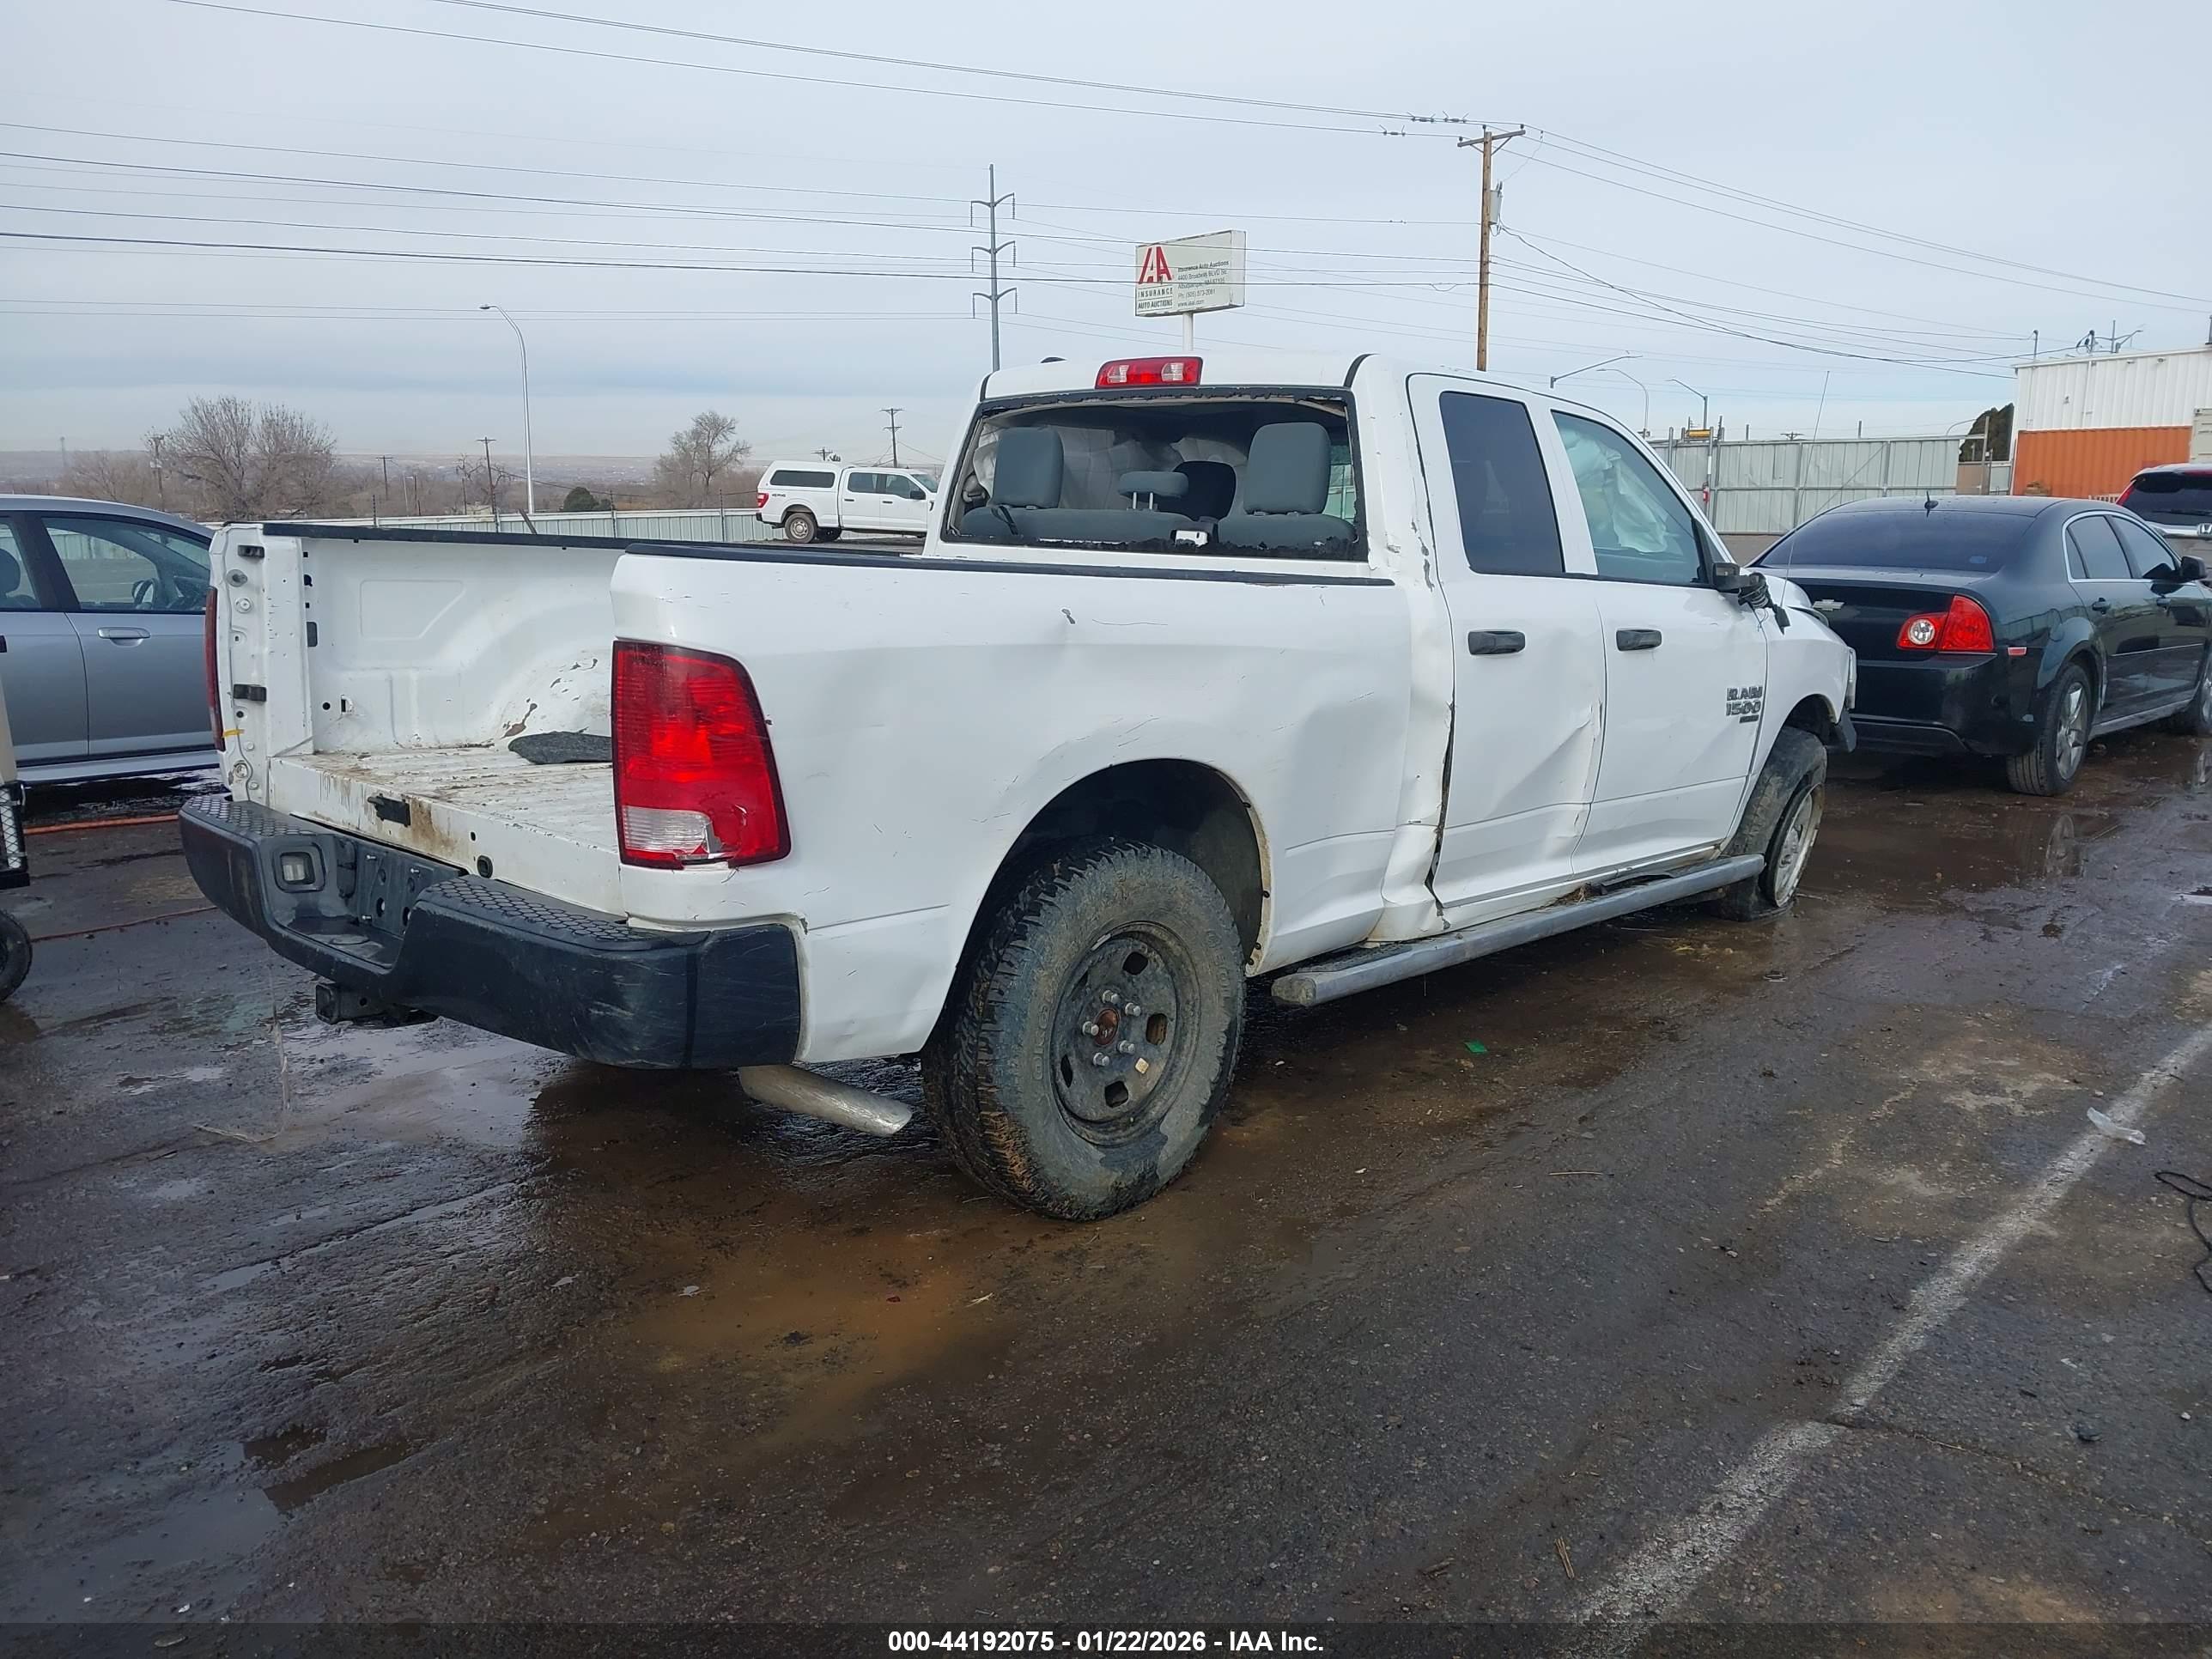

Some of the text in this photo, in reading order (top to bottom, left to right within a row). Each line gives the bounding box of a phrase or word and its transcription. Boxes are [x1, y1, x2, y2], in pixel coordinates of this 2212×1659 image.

[1138, 287, 1173, 298] INSURANCE
[1138, 299, 1173, 310] AUTO AUCTIONS
[1727, 686, 1763, 701] RAM
[1726, 700, 1761, 716] 1500
